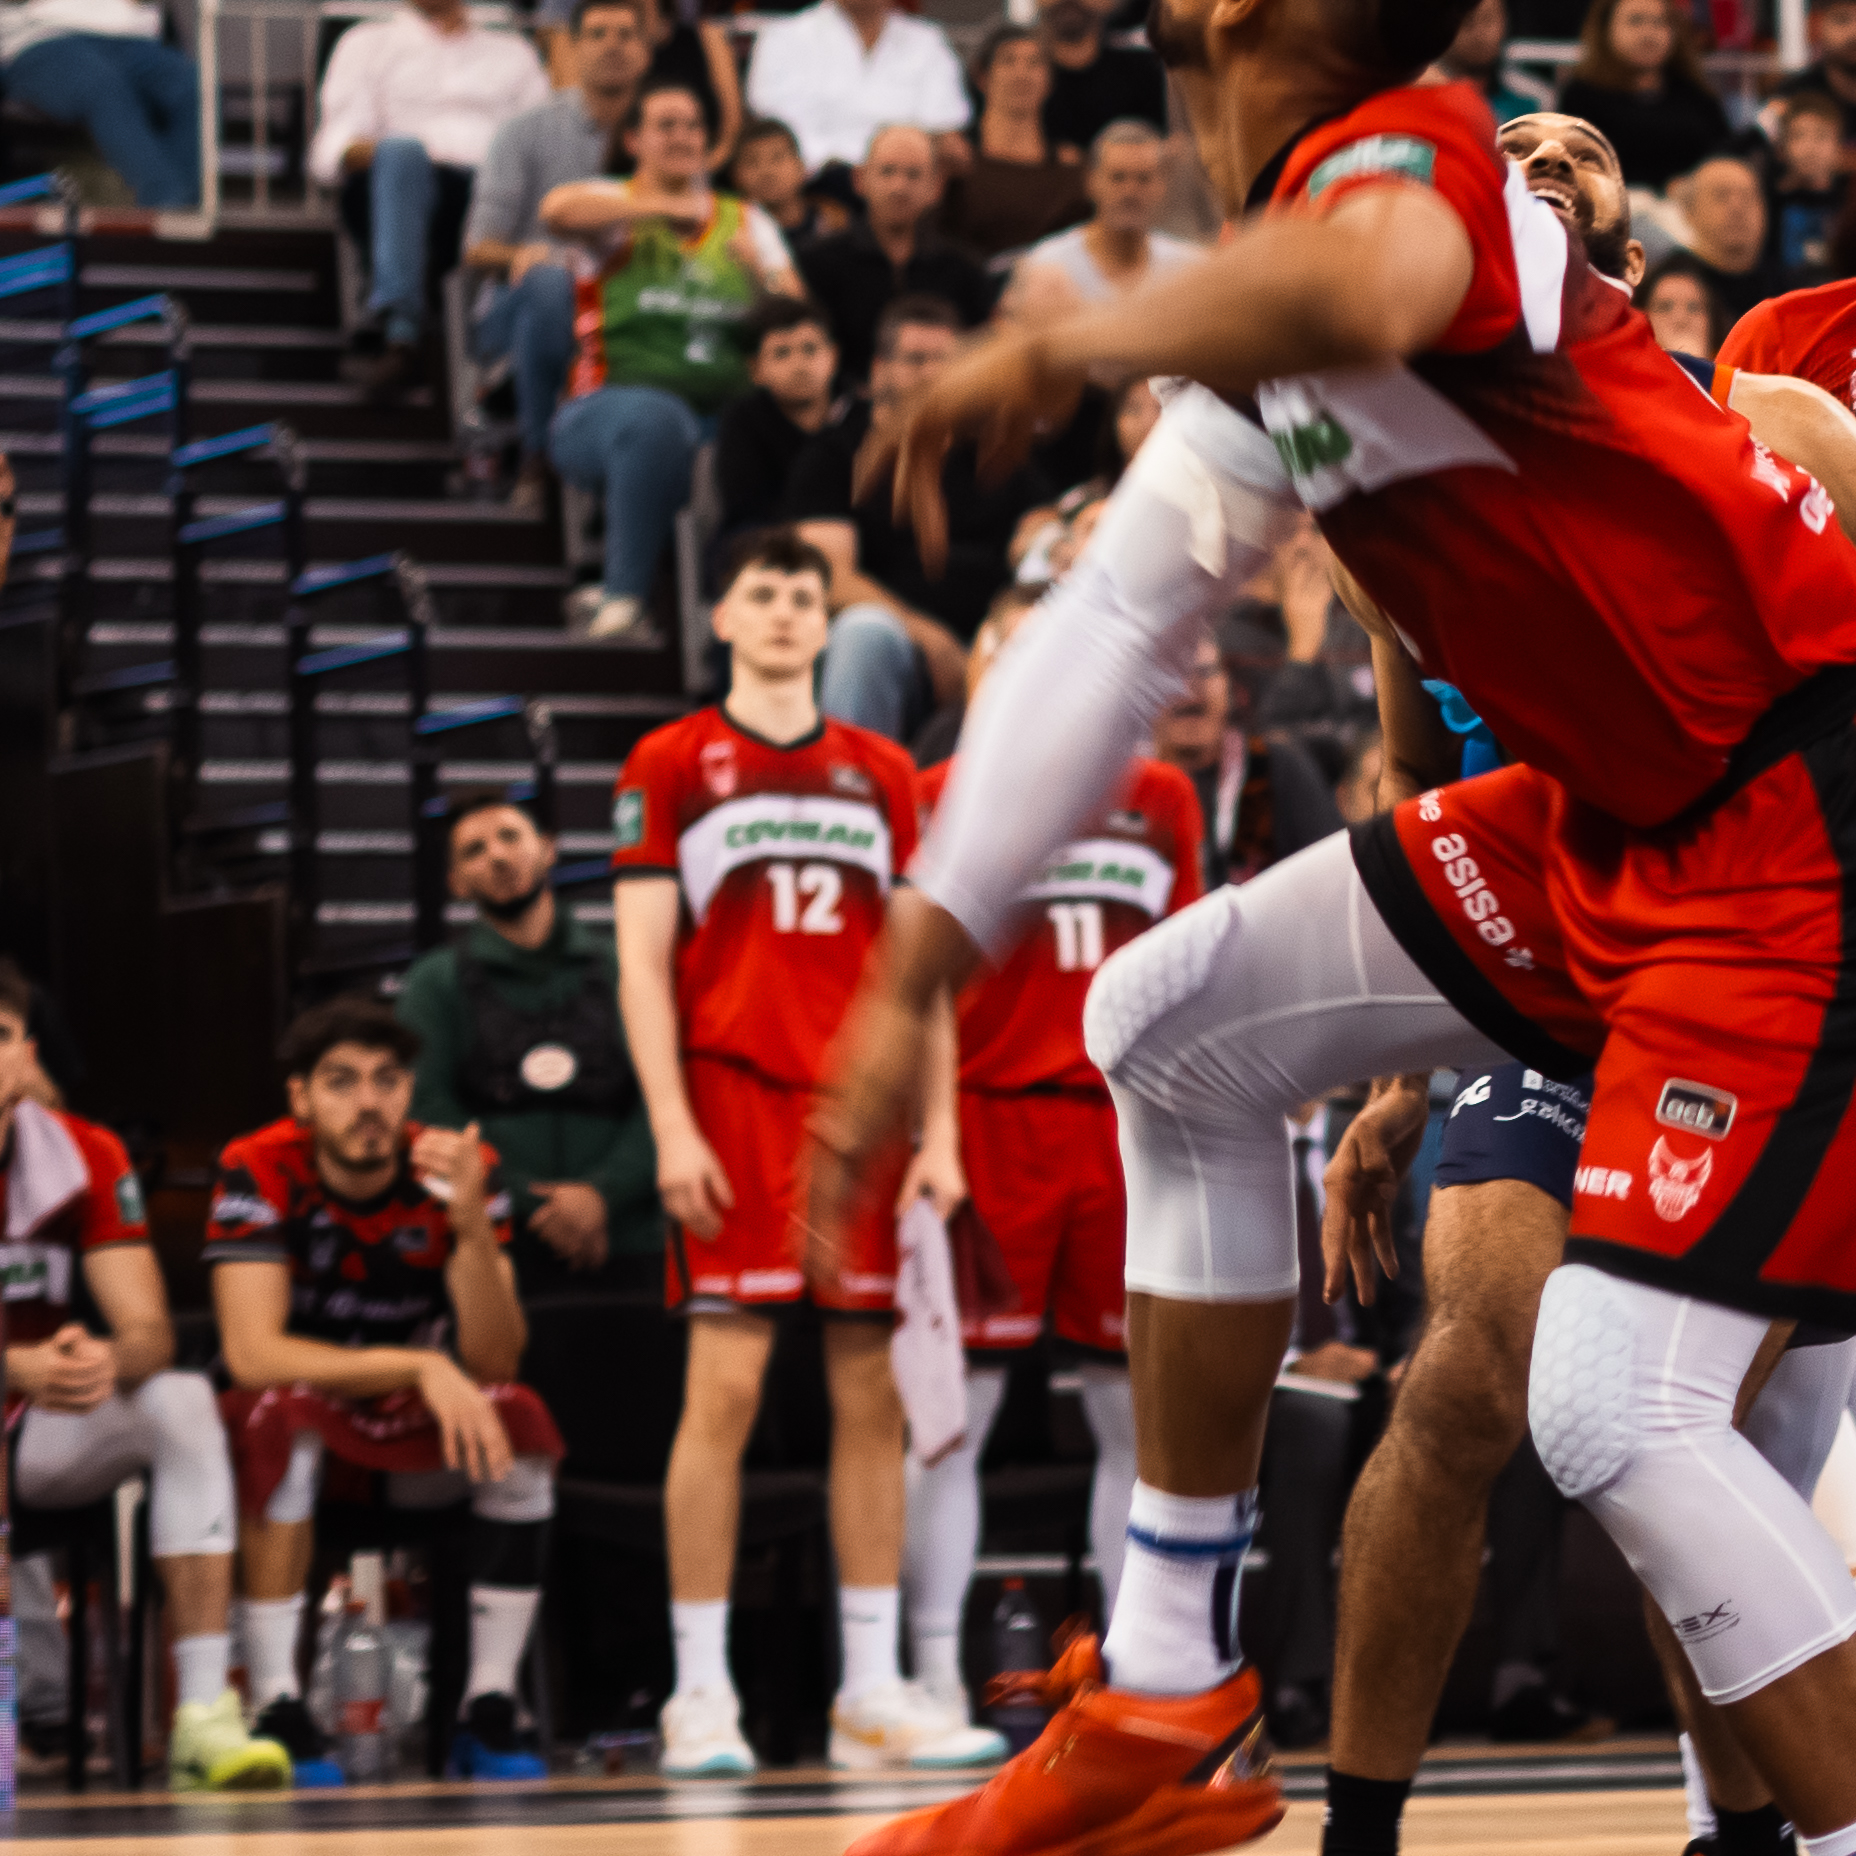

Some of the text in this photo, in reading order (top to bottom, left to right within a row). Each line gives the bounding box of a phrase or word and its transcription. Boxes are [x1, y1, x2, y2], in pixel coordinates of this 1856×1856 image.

[767, 862, 846, 935] 12
[1431, 832, 1516, 946] asisa
[1047, 903, 1103, 973] 11
